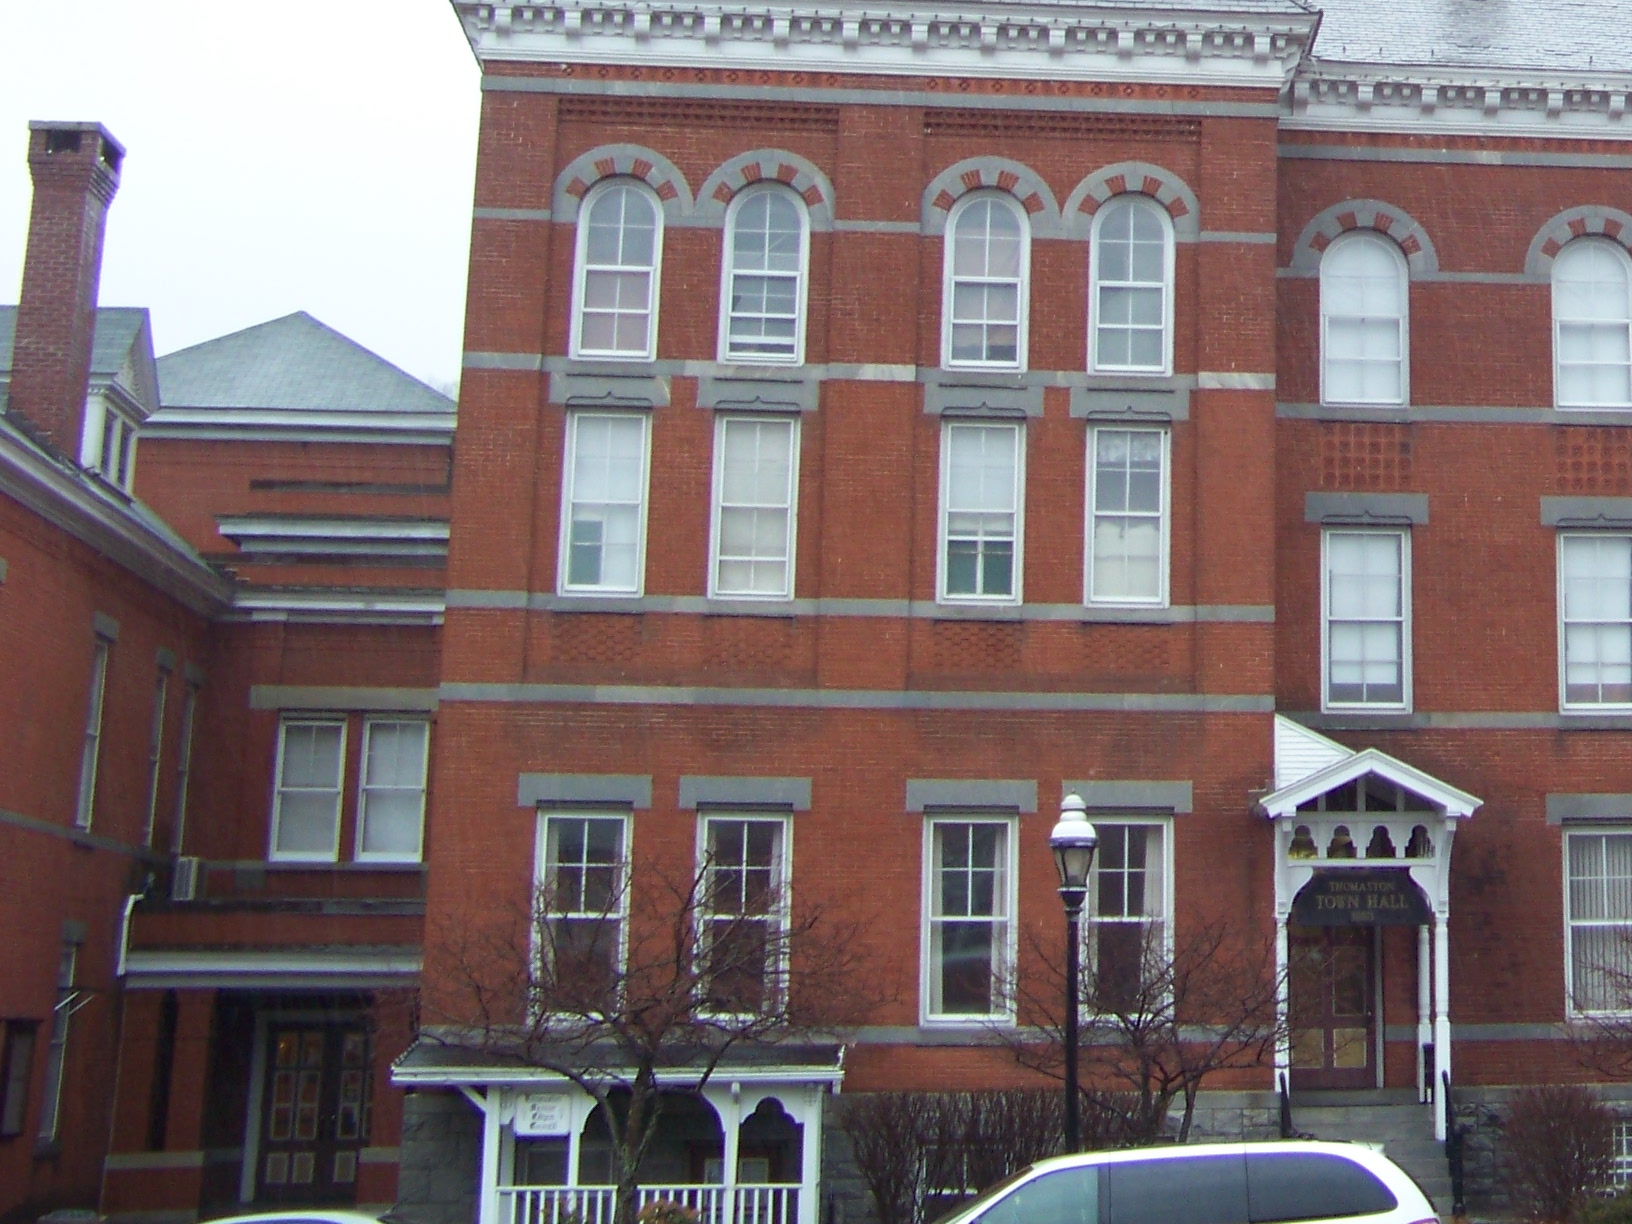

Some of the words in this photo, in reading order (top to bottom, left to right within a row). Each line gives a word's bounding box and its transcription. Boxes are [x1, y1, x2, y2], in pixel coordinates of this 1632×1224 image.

[1328, 881, 1395, 893] THOMASTON
[1315, 894, 1360, 909] TOWN
[1366, 893, 1409, 909] HALL
